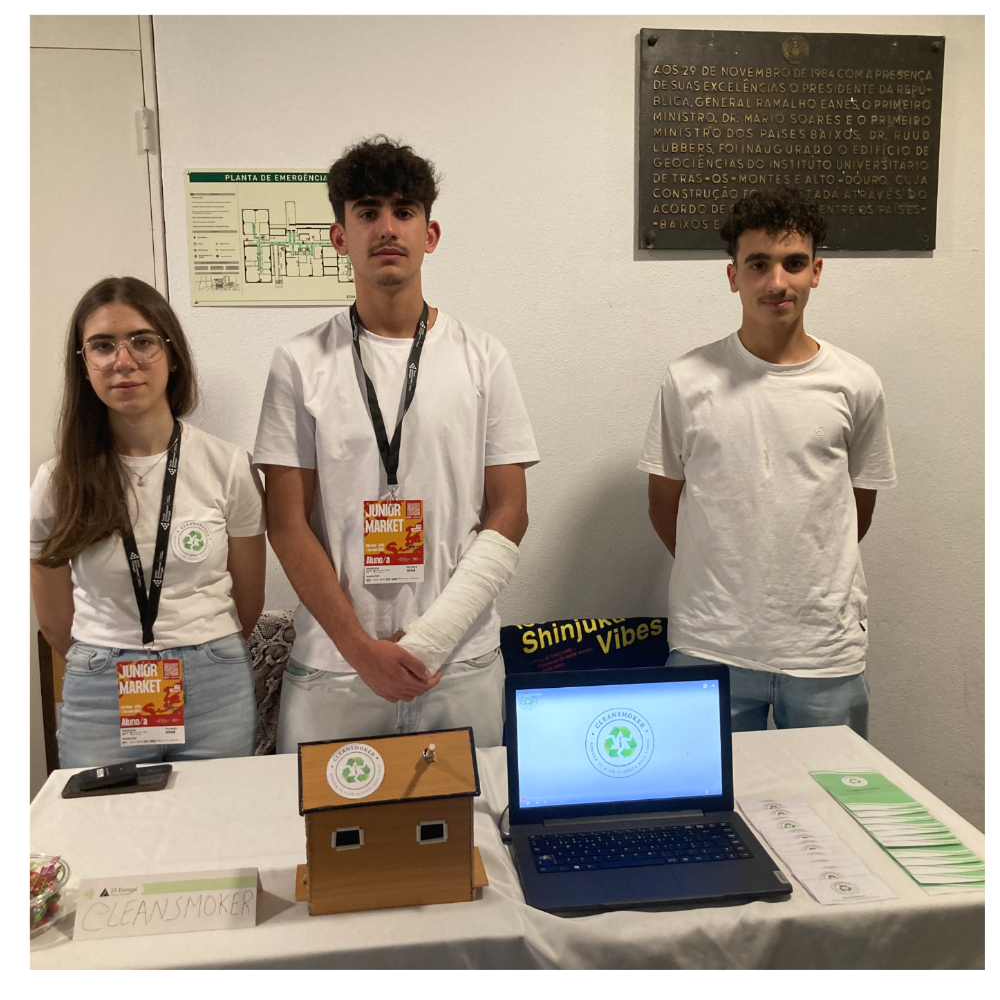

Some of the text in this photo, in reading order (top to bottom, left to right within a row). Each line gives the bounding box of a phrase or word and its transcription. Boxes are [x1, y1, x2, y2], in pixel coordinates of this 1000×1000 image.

[653, 64, 933, 82] AOS 29 DE NOVEMBRO DE 1984 COM A PRESENÇA
[653, 79, 668, 90] DE
[671, 80, 700, 91] SUAS
[703, 78, 786, 93] EXCELÊNCIAS
[789, 83, 799, 93] O
[802, 83, 875, 94] PRESIDENTE
[879, 84, 894, 94] DA
[653, 96, 693, 108] BLICA,
[694, 97, 752, 108] GENERAL
[756, 98, 817, 109] RAMALHO
[862, 100, 871, 110] O
[874, 99, 931, 110] PRIMEIRO
[722, 113, 739, 123] DR.
[790, 114, 841, 125] SOARES
[846, 115, 853, 125] E
[857, 115, 867, 125] O
[870, 115, 931, 126] PRIMEIRO
[653, 128, 722, 138] MINISTRO
[726, 128, 754, 139] DOS
[869, 130, 887, 141] DR.
[894, 131, 930, 141] RUUD
[719, 143, 738, 154] FOI
[741, 144, 833, 155] INAUGURADO
[838, 145, 848, 155] O
[853, 144, 911, 156] EDIFÍCIO
[915, 145, 929, 156] DE
[653, 154, 744, 169] GEOCIÊNCIAS
[747, 159, 765, 169] DO
[769, 160, 832, 170] INSTITUTO
[224, 173, 327, 182] PLANTA DE EMERGÊNCIA
[653, 173, 668, 184] DE
[794, 174, 801, 184] E
[895, 175, 928, 185] CUJA
[653, 186, 739, 201] CONSTRUÇÃO
[908, 188, 928, 200] DO
[653, 204, 707, 214] ACORDO
[711, 204, 726, 214] DE
[820, 205, 855, 215] ENTRE
[858, 205, 874, 215] OS
[713, 220, 720, 230] E
[365, 503, 401, 517] JUNIOR
[365, 519, 404, 533] MARKET
[366, 555, 390, 565] Aluno/a
[597, 619, 663, 654] Vibes
[119, 663, 158, 678] JUNIOR
[119, 679, 162, 695] MARKET
[121, 717, 148, 727] Aluno/a
[595, 711, 645, 729] CLEANSMOKER
[332, 745, 376, 762] CLEANSMOKER
[81, 889, 254, 932] CLEANSMOKER
